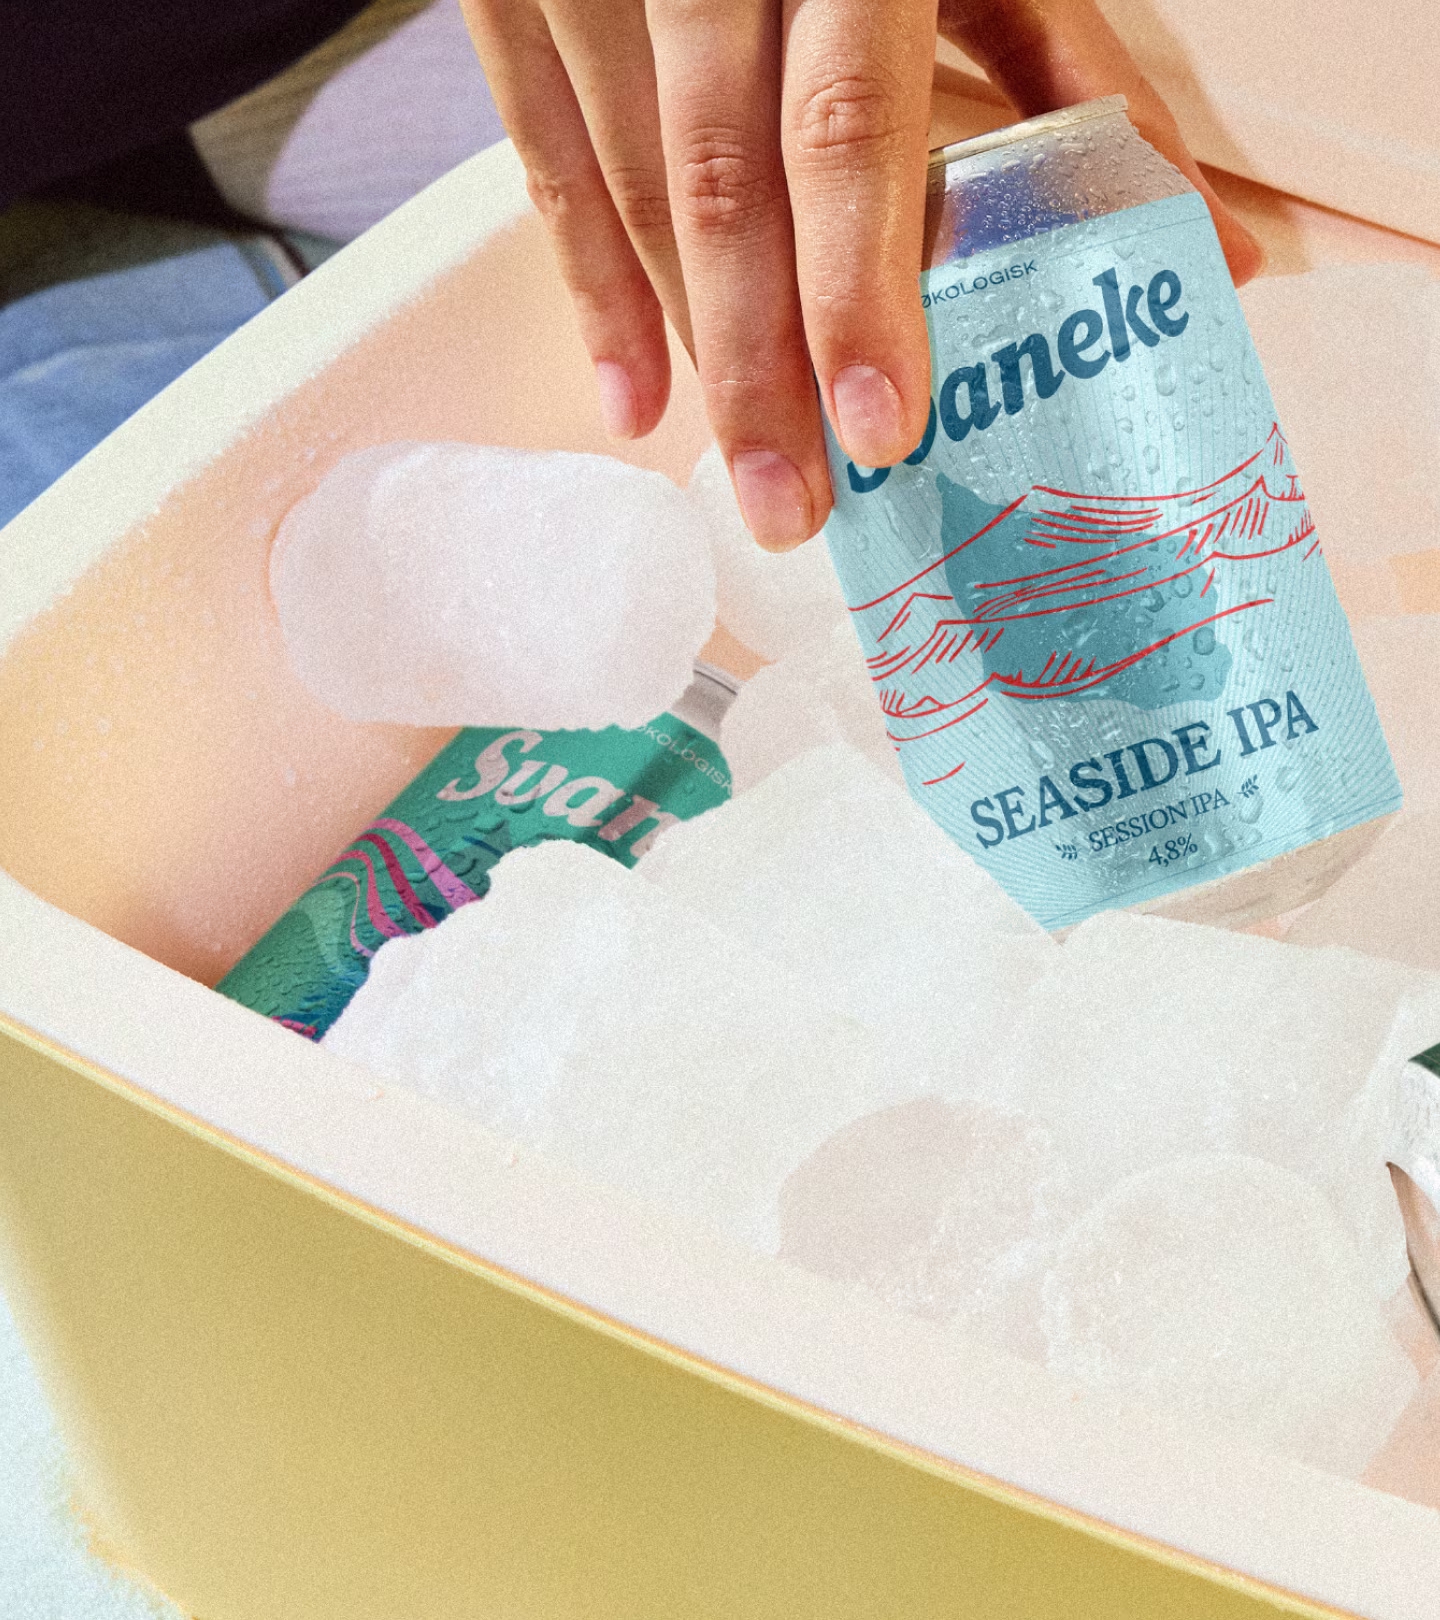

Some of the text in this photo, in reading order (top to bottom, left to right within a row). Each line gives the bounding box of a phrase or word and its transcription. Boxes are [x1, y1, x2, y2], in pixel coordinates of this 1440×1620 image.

[920, 260, 1038, 308] ØKOLOGISK
[847, 267, 1189, 493] aneke
[639, 726, 732, 796] KOLOGISK
[969, 689, 1319, 849] SEASIDE IPA
[1088, 788, 1230, 852] SESSION IPA
[1148, 833, 1198, 867] 4,8%
